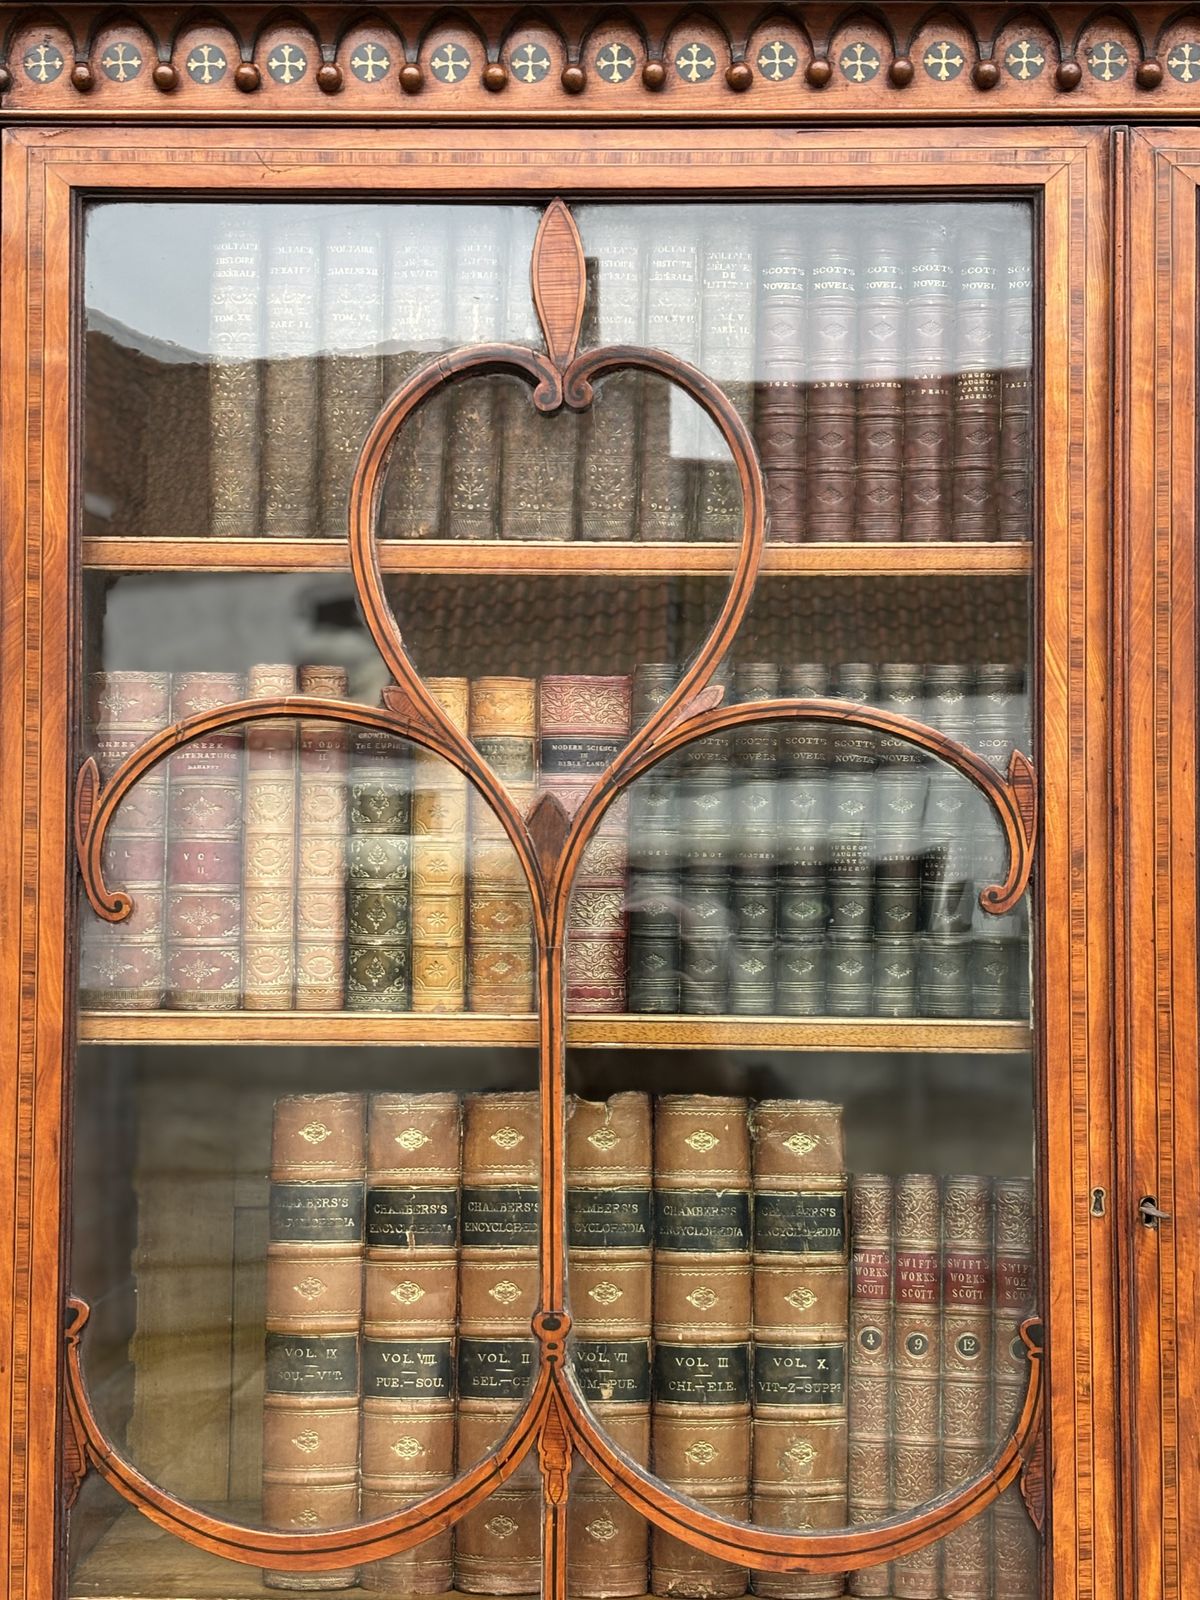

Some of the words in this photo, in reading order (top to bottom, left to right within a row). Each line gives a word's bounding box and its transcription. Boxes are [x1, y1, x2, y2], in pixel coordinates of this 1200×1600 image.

[763, 266, 805, 276] SCOTT'S
[813, 266, 856, 276] SCOTT'S
[763, 282, 805, 291] NOVELS
[814, 281, 856, 291] NOVELS
[785, 737, 827, 746] SCOTT'S
[834, 739, 876, 749] SCOTT'S
[689, 752, 729, 761] NOVELS
[835, 754, 876, 764] NOVELS
[663, 1205, 737, 1217] CHAMBERS'S
[854, 1252, 890, 1265] SWIFT'S
[898, 1256, 938, 1270] SWIFT'S
[947, 1258, 990, 1271] SWIFT'S
[900, 1271, 938, 1283] WORKS.
[901, 1289, 935, 1300] SCOTT.
[866, 1333, 876, 1346] 4
[914, 1338, 923, 1351] 9
[963, 1338, 976, 1351] 12
[285, 1347, 317, 1358] VOL.
[381, 1352, 415, 1364] VOL.
[477, 1352, 511, 1363] VOL.
[577, 1351, 610, 1363] VOL.
[675, 1357, 709, 1368] VOL.
[772, 1357, 807, 1368] VOL.
